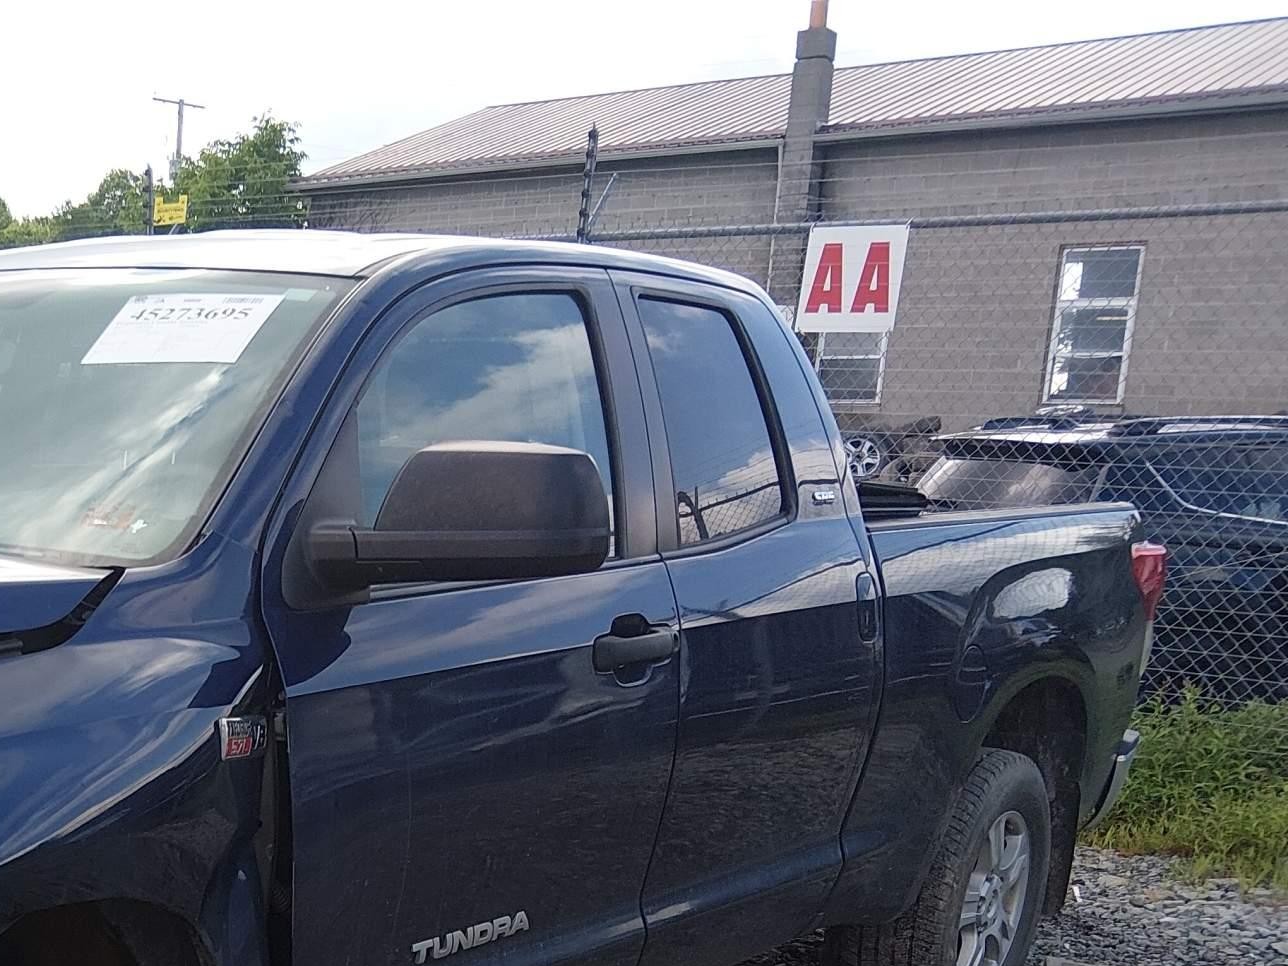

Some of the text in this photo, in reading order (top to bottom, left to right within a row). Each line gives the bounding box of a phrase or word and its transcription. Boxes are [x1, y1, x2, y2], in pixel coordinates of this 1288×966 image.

[804, 241, 890, 313] AA
[129, 307, 254, 321] 45273695
[412, 910, 530, 965] TUNDRA
